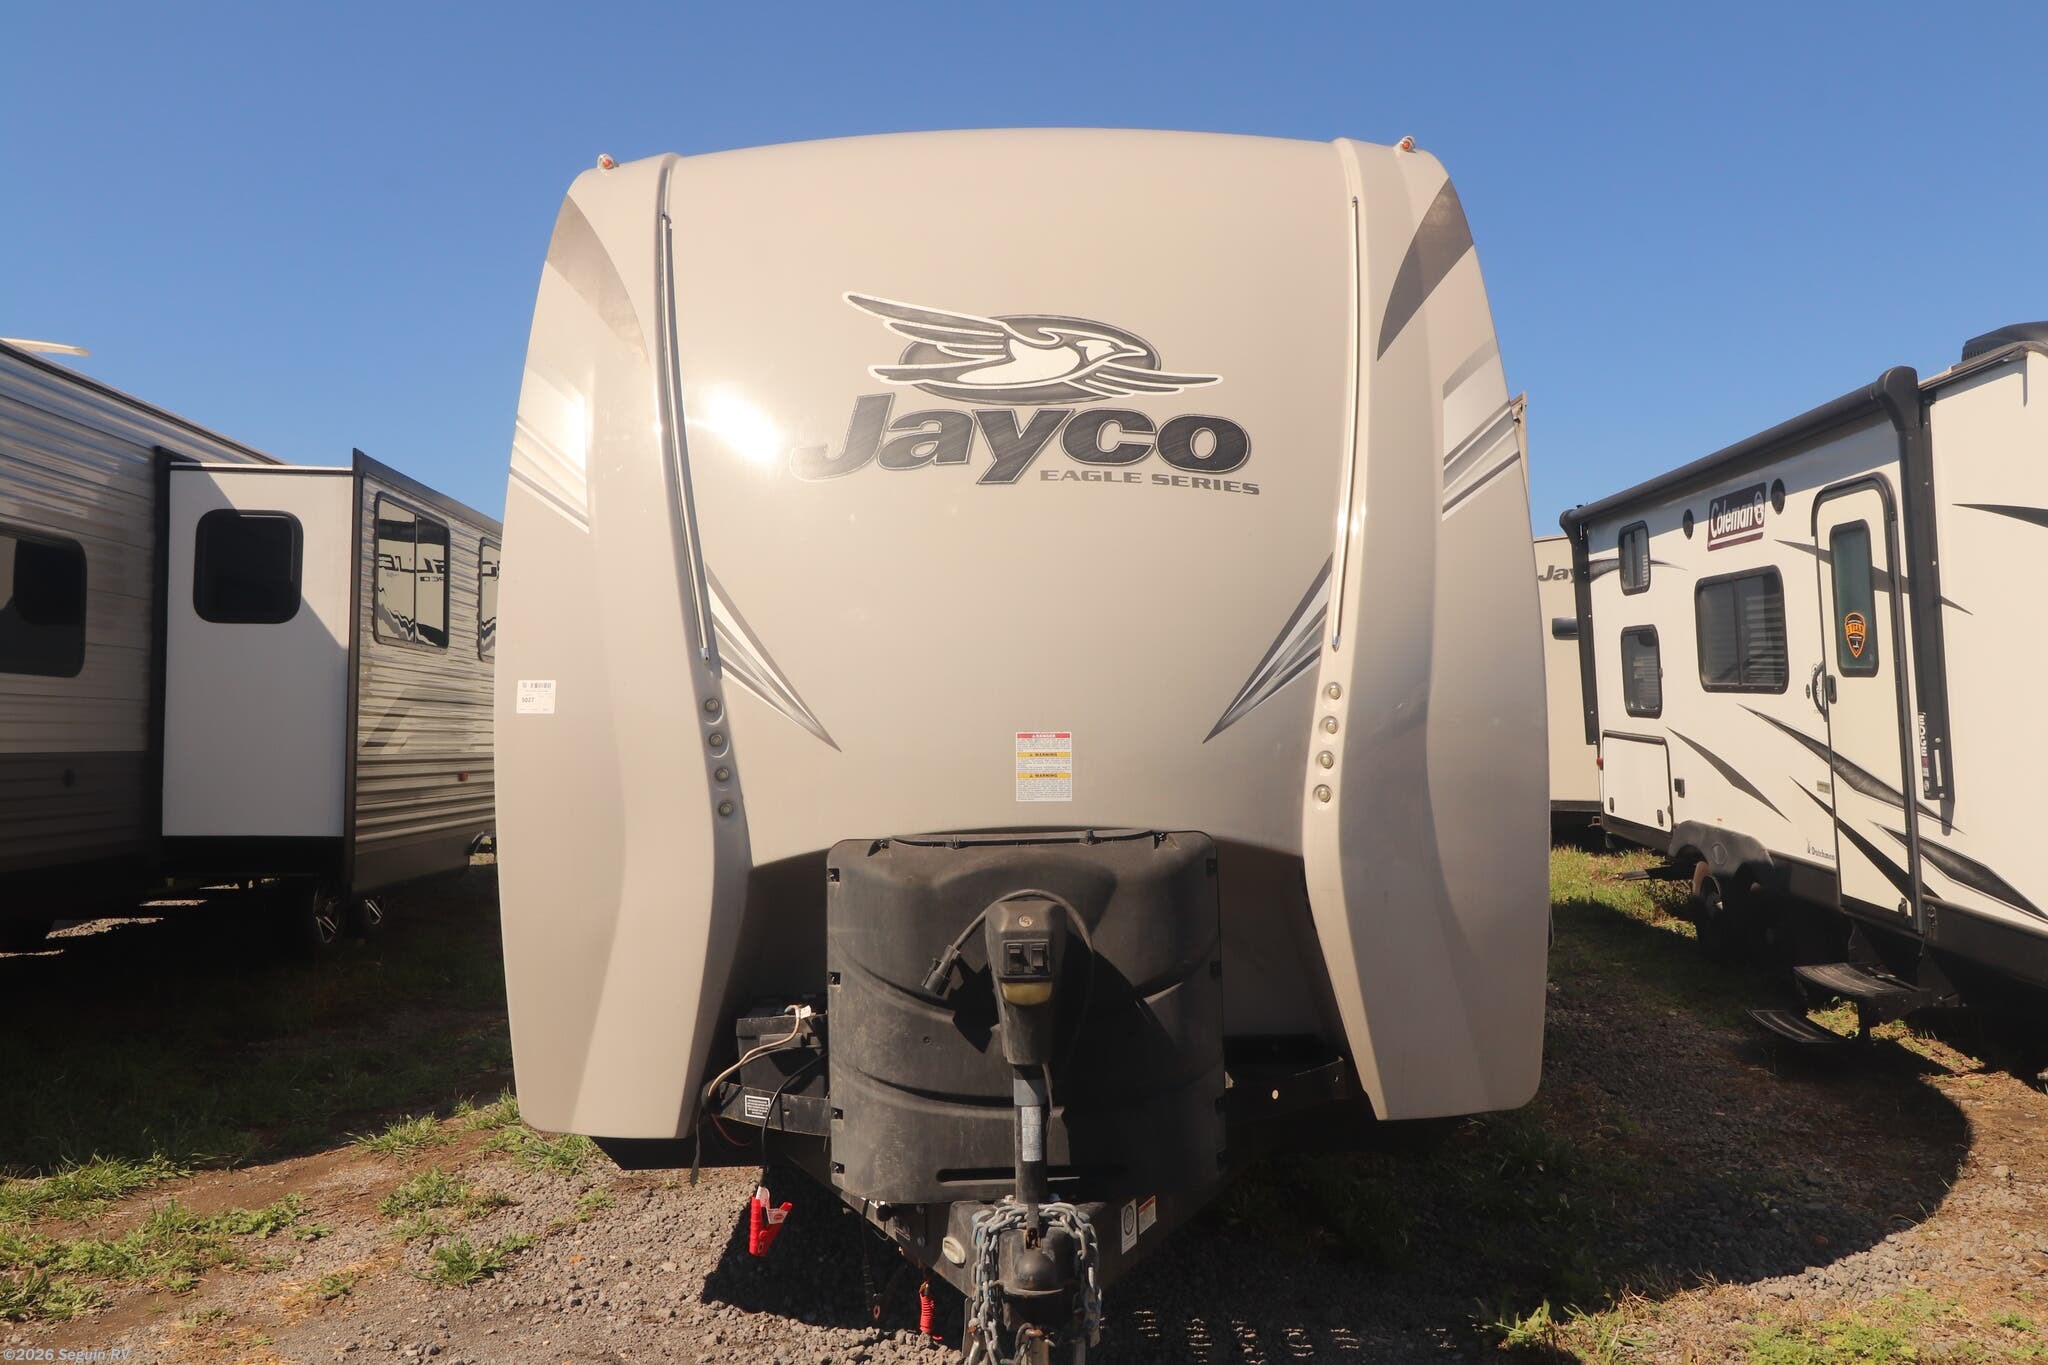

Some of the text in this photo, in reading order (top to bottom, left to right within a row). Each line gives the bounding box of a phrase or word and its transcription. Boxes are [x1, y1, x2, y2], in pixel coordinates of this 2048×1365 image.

[789, 392, 1253, 485] Jayco
[1039, 470, 1261, 495] EAGLE SERIES
[1710, 500, 1754, 538] Coleman
